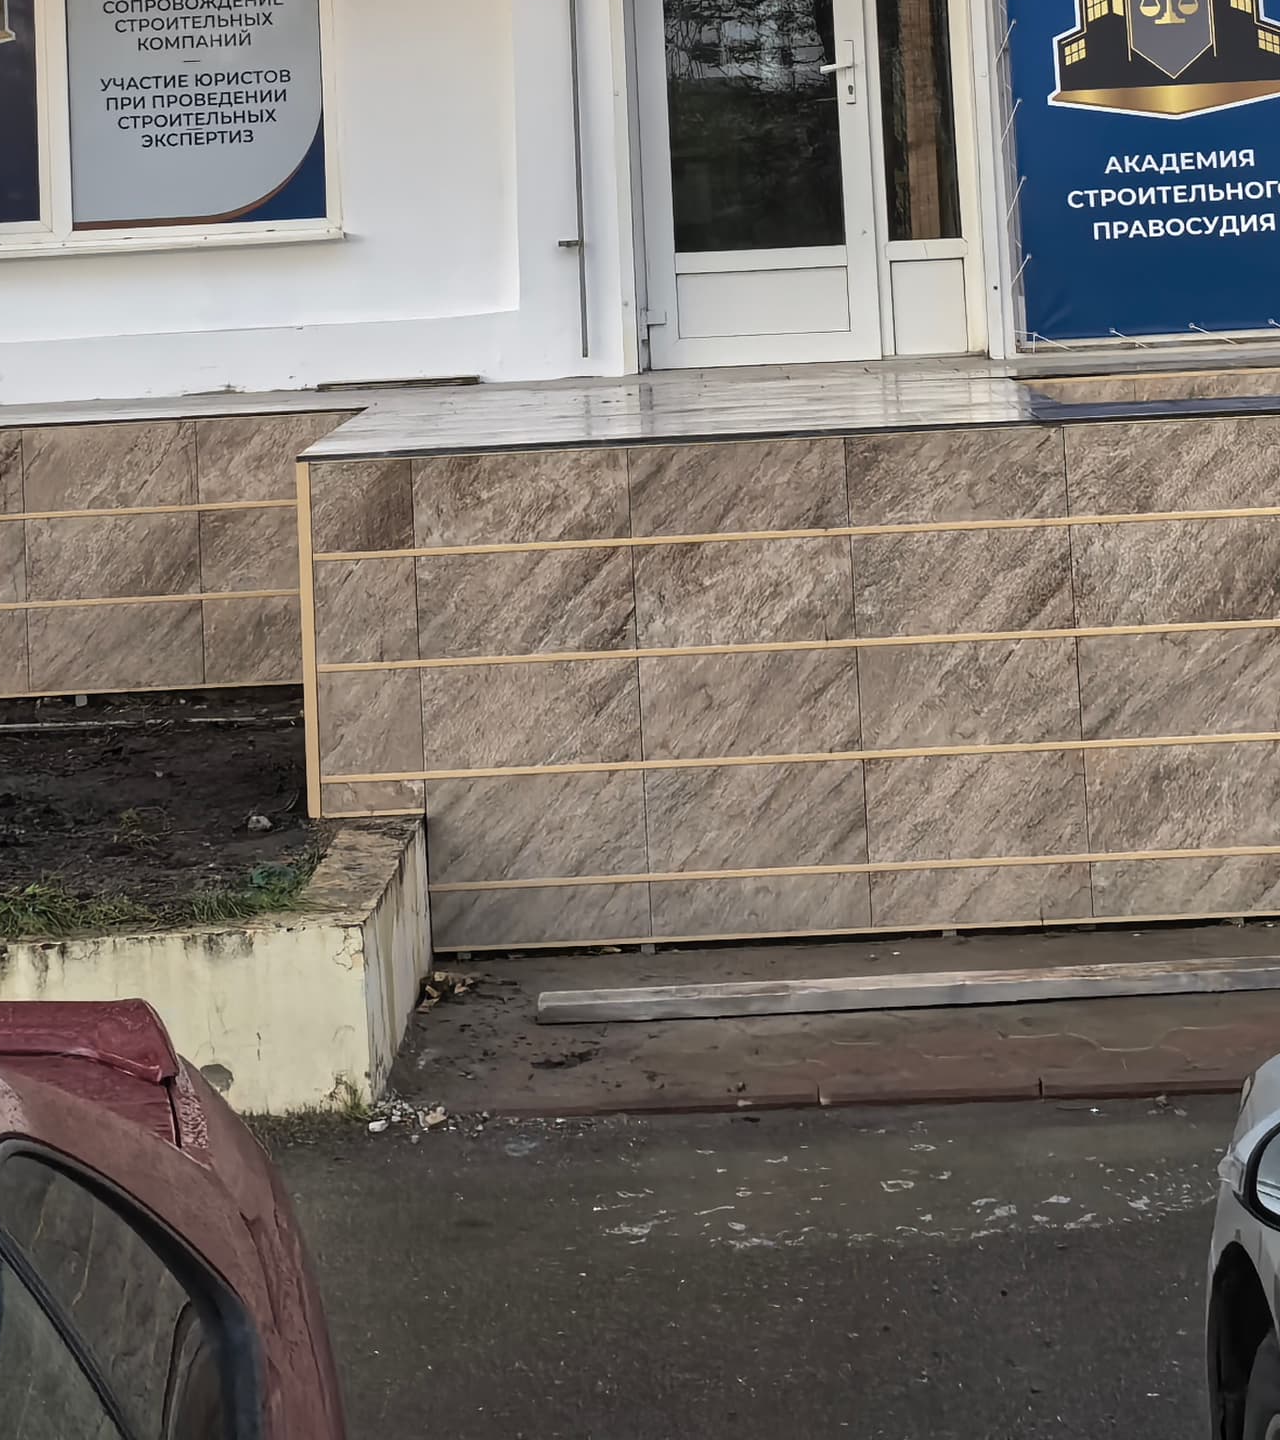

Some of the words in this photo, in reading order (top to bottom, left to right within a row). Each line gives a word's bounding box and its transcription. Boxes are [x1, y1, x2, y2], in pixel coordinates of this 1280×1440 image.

[114, 12, 273, 33] СТРОИТЕЛЬНЫХ
[137, 30, 252, 51] КОМПАНИЙ
[100, 74, 189, 92] УЧАСТИЕ
[194, 68, 291, 88] ЮРИСТОВ
[106, 96, 145, 111] ПРИ
[152, 88, 287, 109] ПРОВЕДЕНИИ
[118, 108, 277, 130] СТРОИТЕЛЬНЫХ
[141, 129, 255, 148] ЭКСПЕРТИЗ
[1104, 149, 1255, 175] АКАДЕМИЯ
[1093, 213, 1276, 240] ПРАВОСУДИЯ
